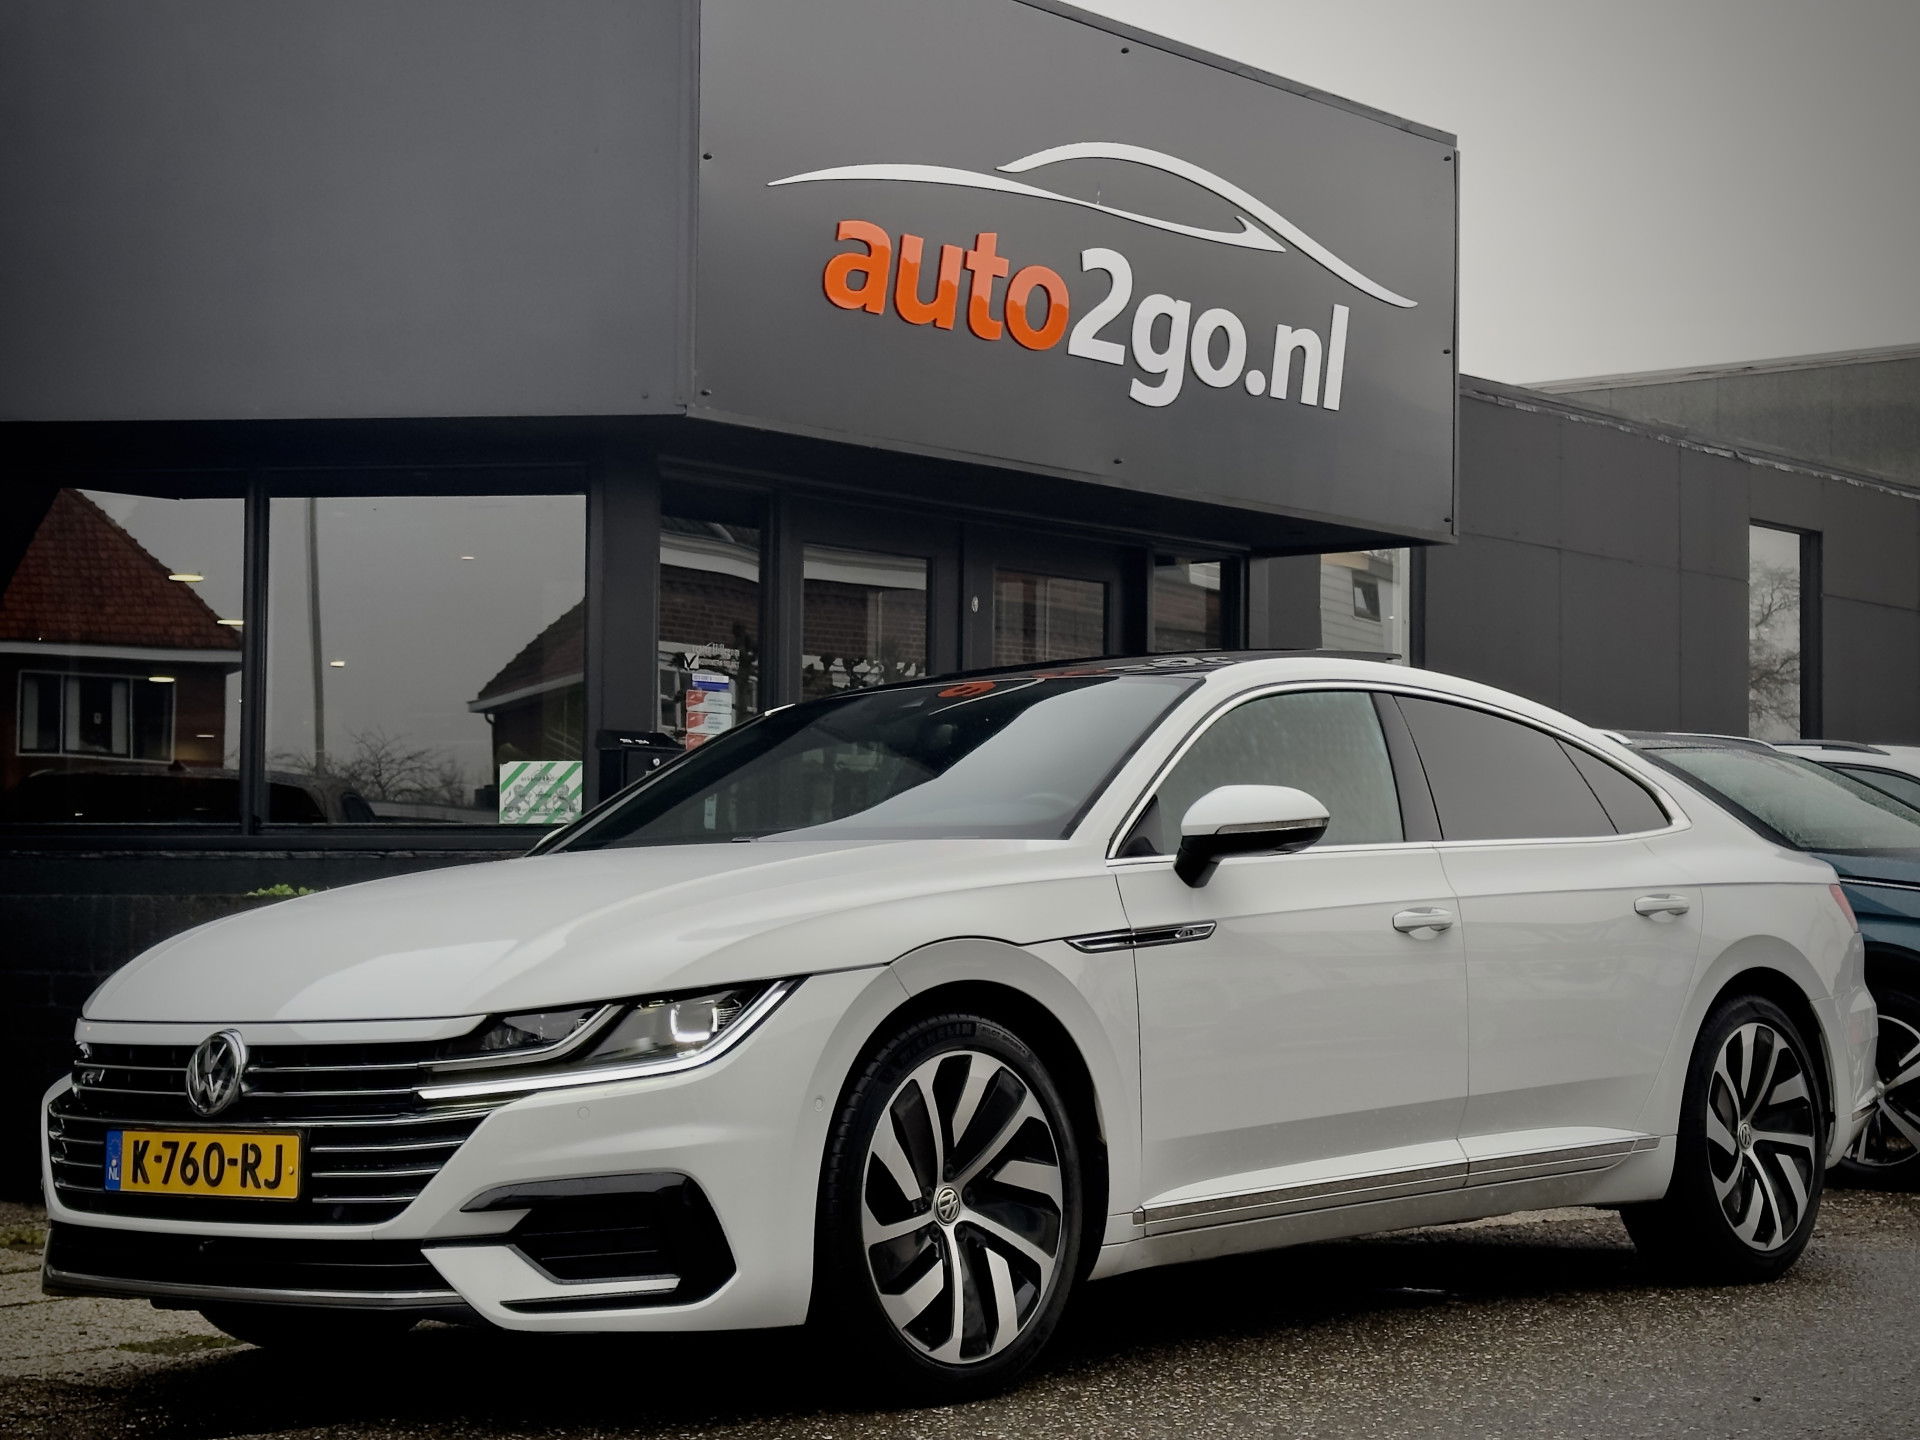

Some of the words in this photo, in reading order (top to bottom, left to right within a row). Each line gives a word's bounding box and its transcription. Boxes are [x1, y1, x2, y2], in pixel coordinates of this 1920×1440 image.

[823, 220, 1350, 411] auto2go.nl
[108, 1165, 120, 1181] NL
[131, 1139, 283, 1190] K-760-RJ
